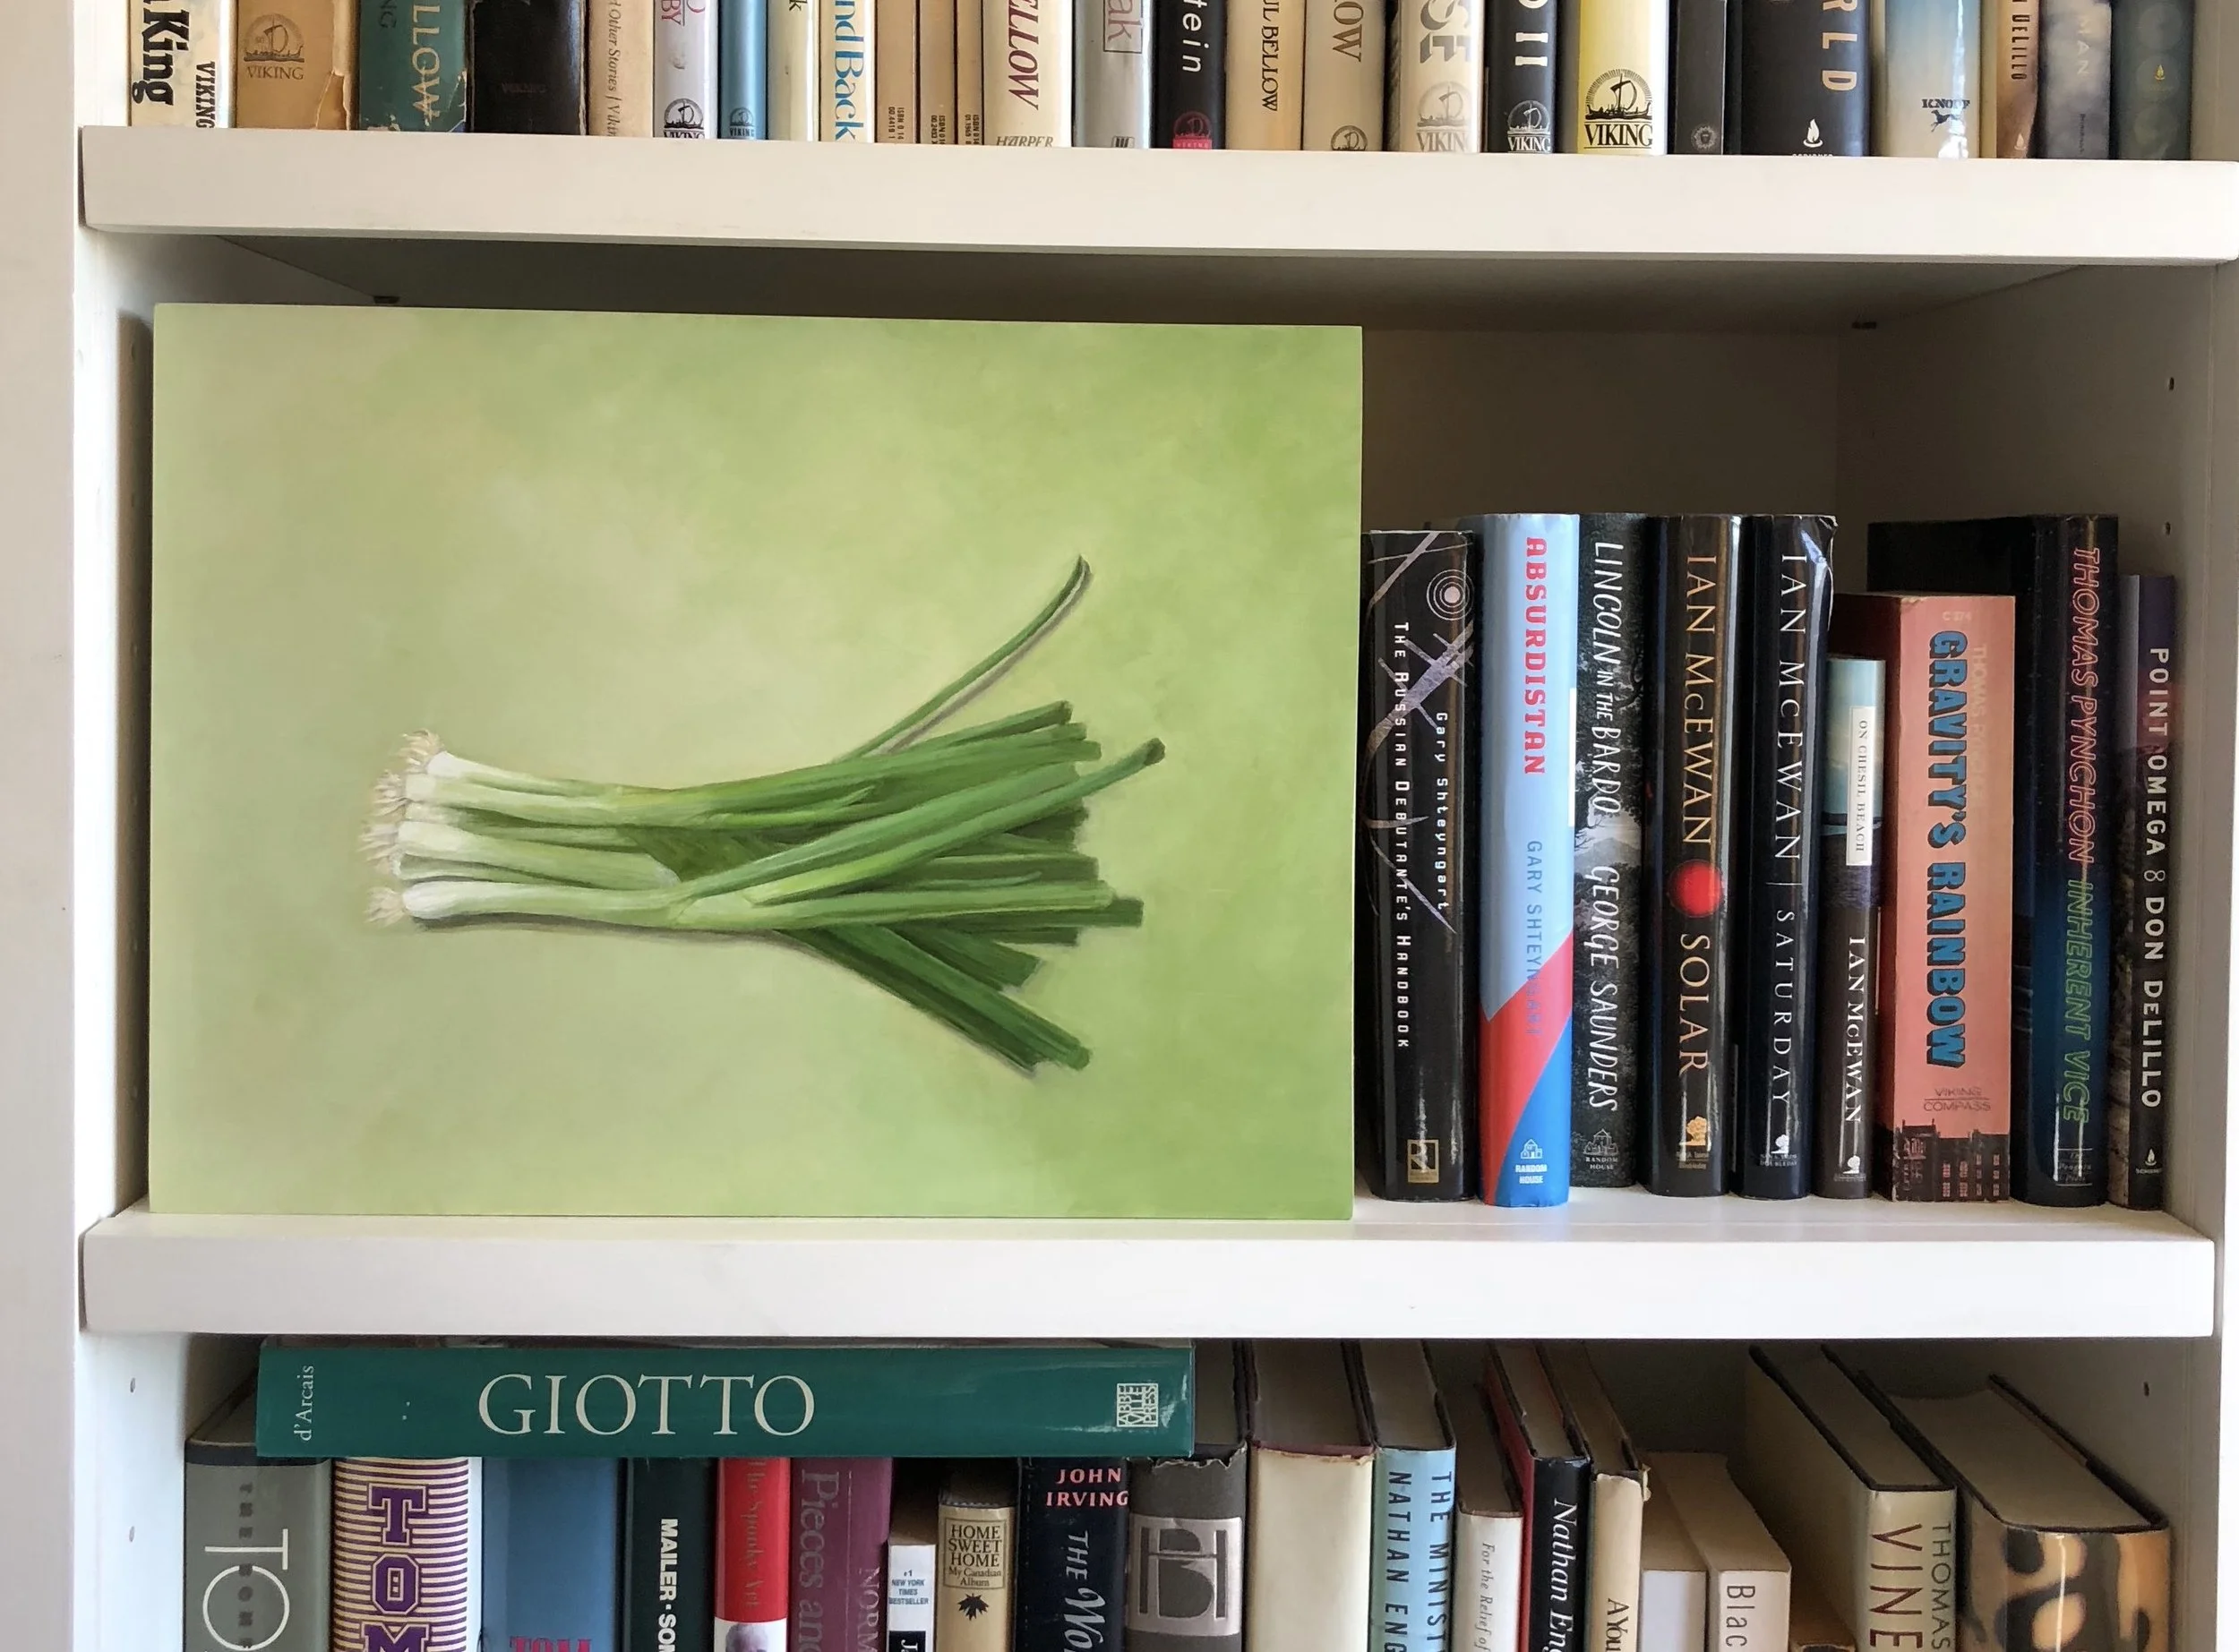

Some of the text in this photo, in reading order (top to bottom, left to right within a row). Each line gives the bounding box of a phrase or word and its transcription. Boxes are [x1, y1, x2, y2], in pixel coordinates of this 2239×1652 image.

[607, 8, 622, 46] Other
[195, 61, 216, 128] VIKING
[246, 65, 305, 81] VIKING
[607, 48, 622, 91] Stories
[835, 50, 864, 141] Back
[1261, 25, 1280, 111] BELLOW
[1416, 132, 1471, 152] VIKIN
[1507, 136, 1551, 151] VIKING
[1584, 124, 1653, 147] VIKING
[1685, 554, 1717, 634] IAN
[1780, 553, 1807, 634] IAN
[2071, 547, 2100, 688] THOMAS
[1394, 621, 1410, 658] THE
[1524, 536, 1548, 775] ABSURDISTAN
[1591, 541, 1625, 814] LINCOLN IN THE BARDO
[2148, 647, 2169, 737] POINT
[1436, 712, 1448, 763] Gary
[1855, 720, 1869, 852] ON CHESIL BEACH
[2068, 694, 2097, 864] PYNCHON
[2146, 754, 2167, 856] OMEGA
[1526, 840, 1543, 894] GARY
[1926, 629, 1968, 1069] GRAVITY'S RAINBOW
[2063, 879, 2093, 1041] INHERENT
[2144, 896, 2165, 960] DON
[1395, 935, 1411, 1048] HANDBOOK
[1583, 865, 1620, 1112] GEORGE SAUNDERS
[1848, 937, 1866, 992] IAN
[1678, 933, 1711, 1076] SOLAR
[1772, 909, 1796, 1104] SATURDAY
[1923, 1100, 1991, 1112] COMPASS
[1934, 1087, 1983, 1097] VIKING
[2063, 1050, 2091, 1125] VICE
[1515, 1164, 1548, 1174] RANDOM
[1519, 1175, 1544, 1185] HOUSE
[294, 1365, 315, 1442] d'Arcais
[478, 1374, 815, 1436] GIOTTO
[1045, 1490, 1128, 1508] IRVING
[1055, 1468, 1122, 1485] JOHN
[659, 1518, 678, 1601] MAILER
[798, 1470, 840, 1588] Pieces
[948, 1538, 1002, 1554] SWEET
[950, 1525, 1001, 1541] HOME
[1385, 1471, 1412, 1583] NATHAN
[1482, 1541, 1496, 1563] For
[1549, 1498, 1579, 1602] Nathan
[948, 1567, 1002, 1579] My Canadian
[949, 1552, 1000, 1568] HOME
[960, 1577, 990, 1588] Album
[1063, 1528, 1107, 1652] THE Wo
[1426, 1470, 1453, 1652] THE MINIST
[1480, 1568, 1494, 1589] the
[1930, 1522, 1952, 1649] THOMAS
[1476, 1594, 1493, 1636] Relief
[1606, 1596, 1630, 1616] A
